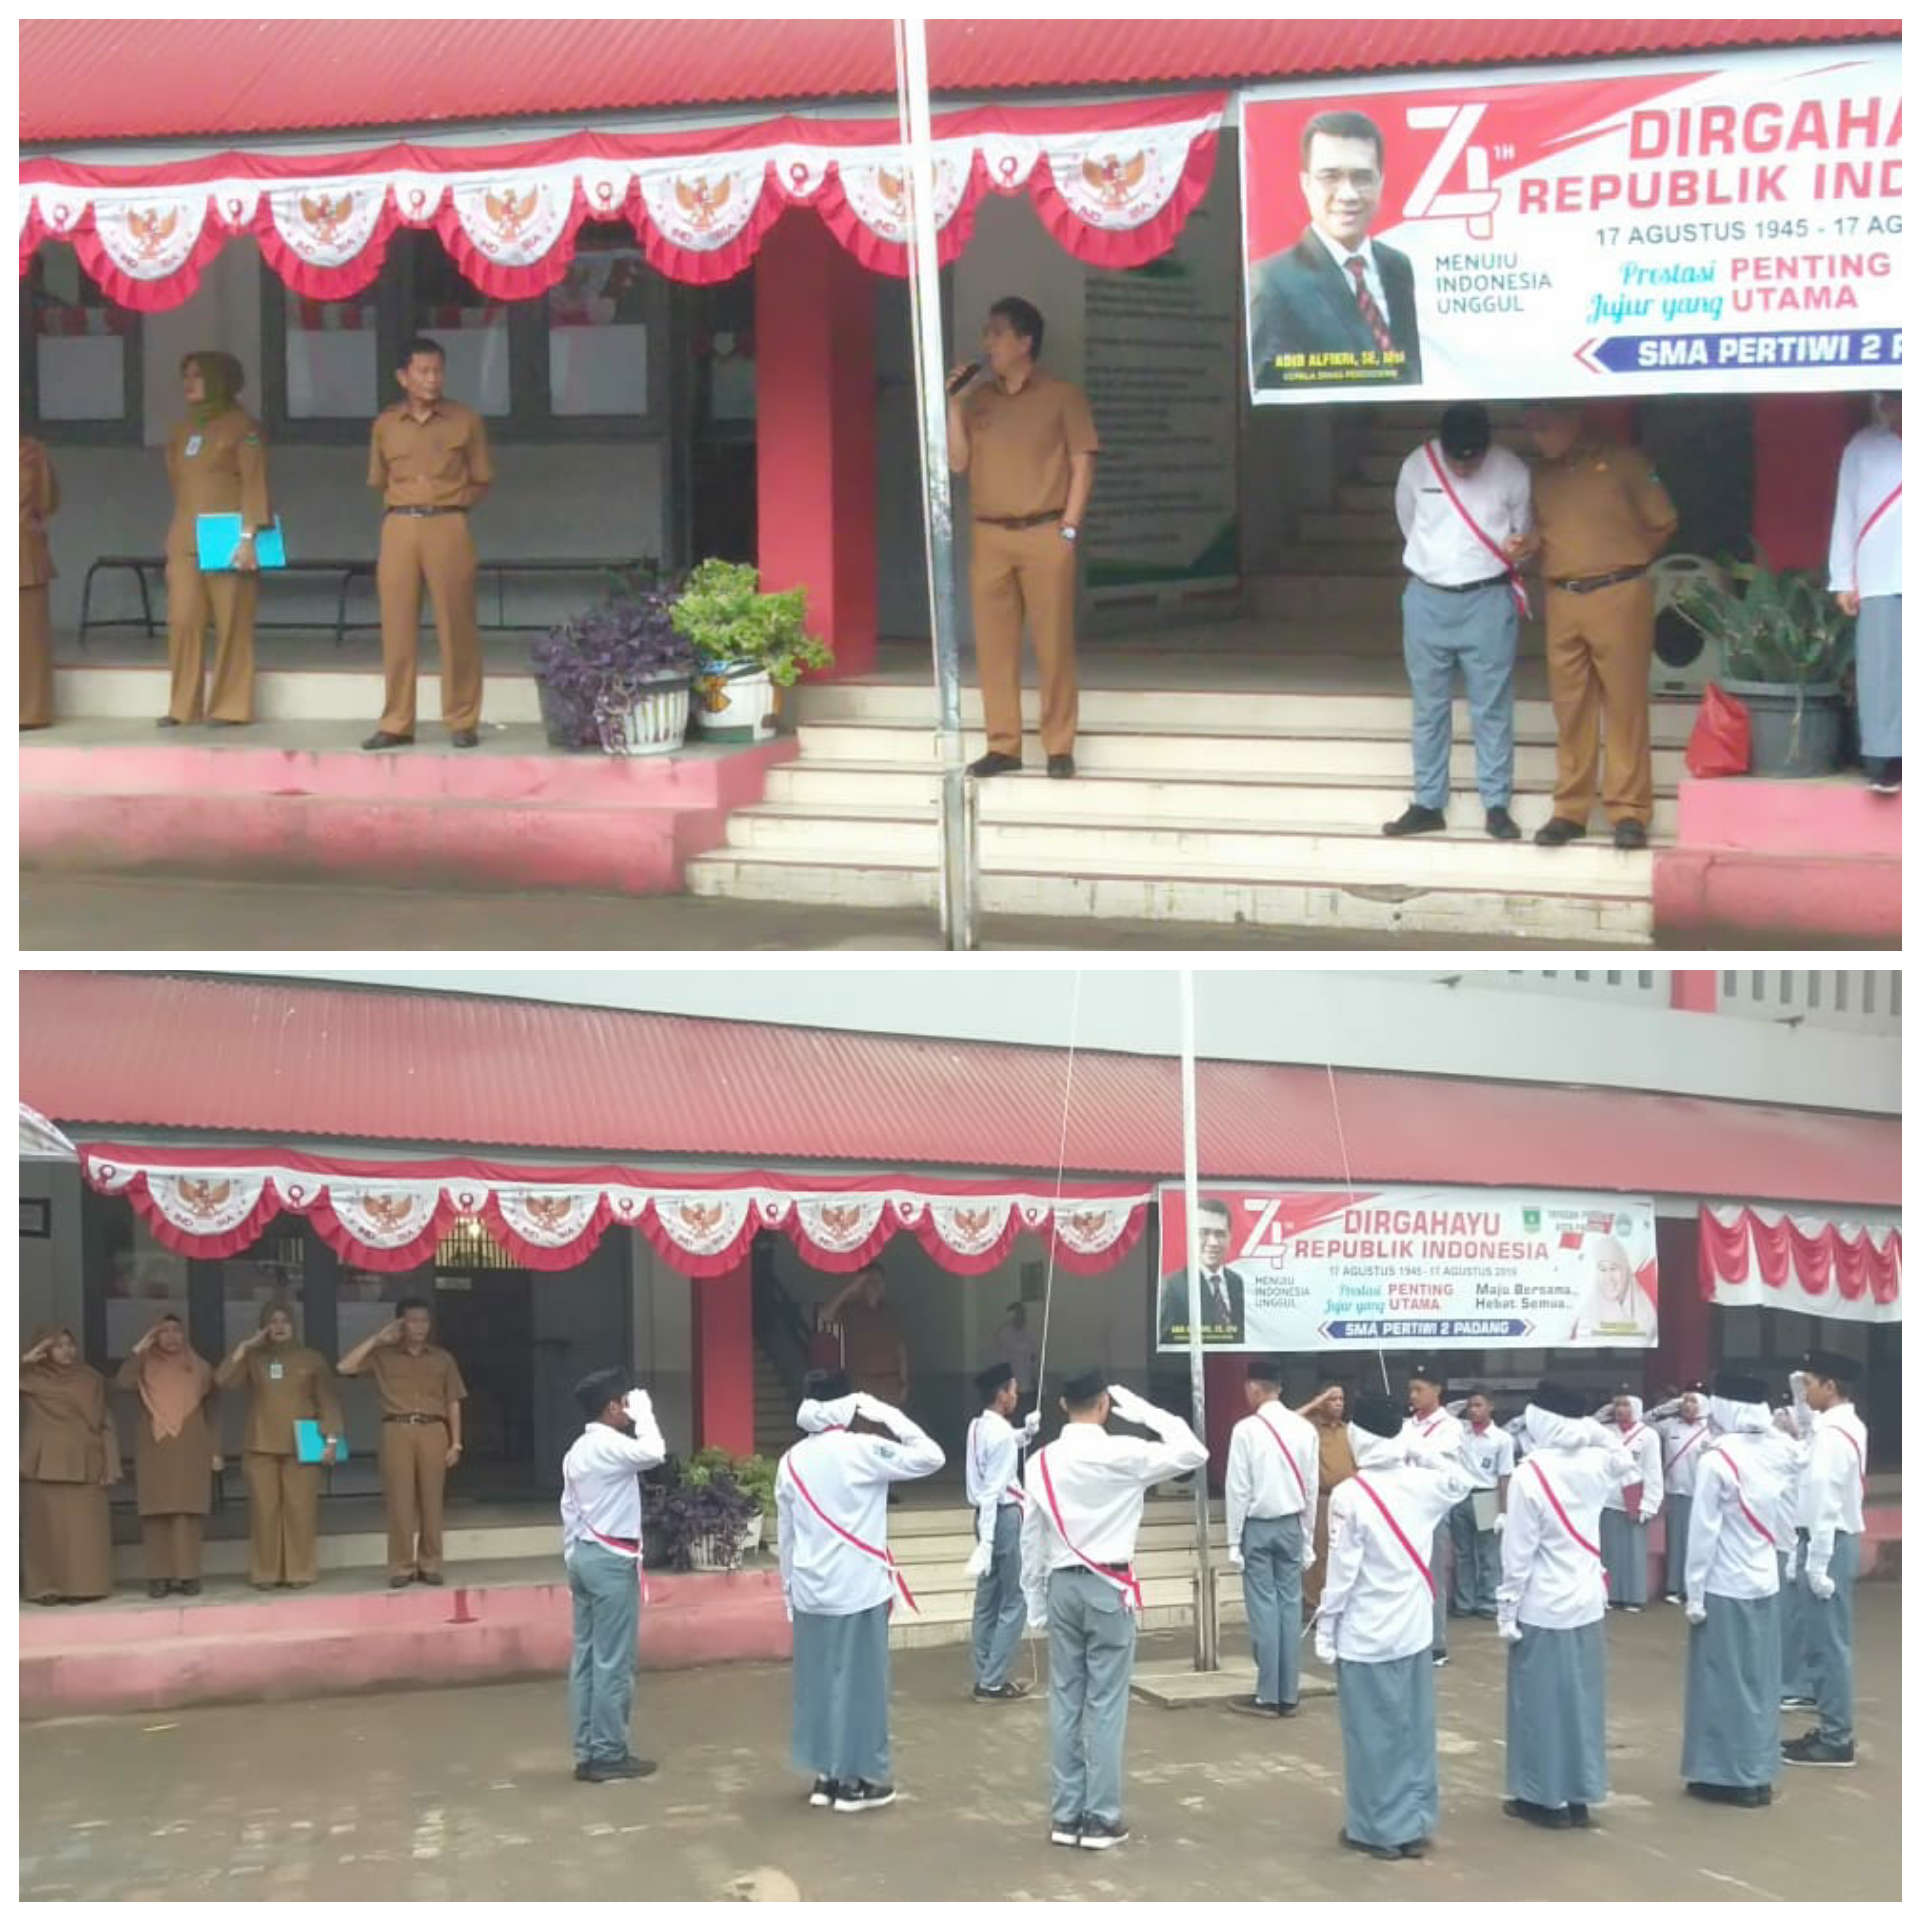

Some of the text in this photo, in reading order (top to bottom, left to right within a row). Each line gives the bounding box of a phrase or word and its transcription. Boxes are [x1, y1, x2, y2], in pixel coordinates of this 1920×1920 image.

[1518, 165, 1788, 215] REPUBLIK
[1596, 227, 1620, 247] 17
[1628, 220, 1746, 246] AGUSTUS
[1755, 218, 1809, 239] 1945
[1833, 216, 1860, 237] 17
[1620, 252, 1891, 286] Prestasi PENTING
[1436, 273, 1553, 293] INDONESIA
[1437, 295, 1525, 315] UNGGUL
[1586, 285, 1858, 325] Jujur yang UTAMA
[1638, 339, 1708, 367] SMA
[1718, 335, 1850, 364] PERTIWI
[1860, 334, 1881, 360] 2
[1343, 1209, 1501, 1236] DIRGAHAYU
[1295, 1239, 1550, 1260] REPUBLIK INDONESIA
[1343, 1265, 1395, 1277] AGUSTUS
[1443, 1265, 1492, 1277] AGUSTUS
[1388, 1283, 1454, 1296] PENTING
[1476, 1282, 1510, 1297] Maju
[1388, 1298, 1440, 1311] UTAMA
[1344, 1321, 1510, 1336] SMA PERTIWI 2 PADANG
